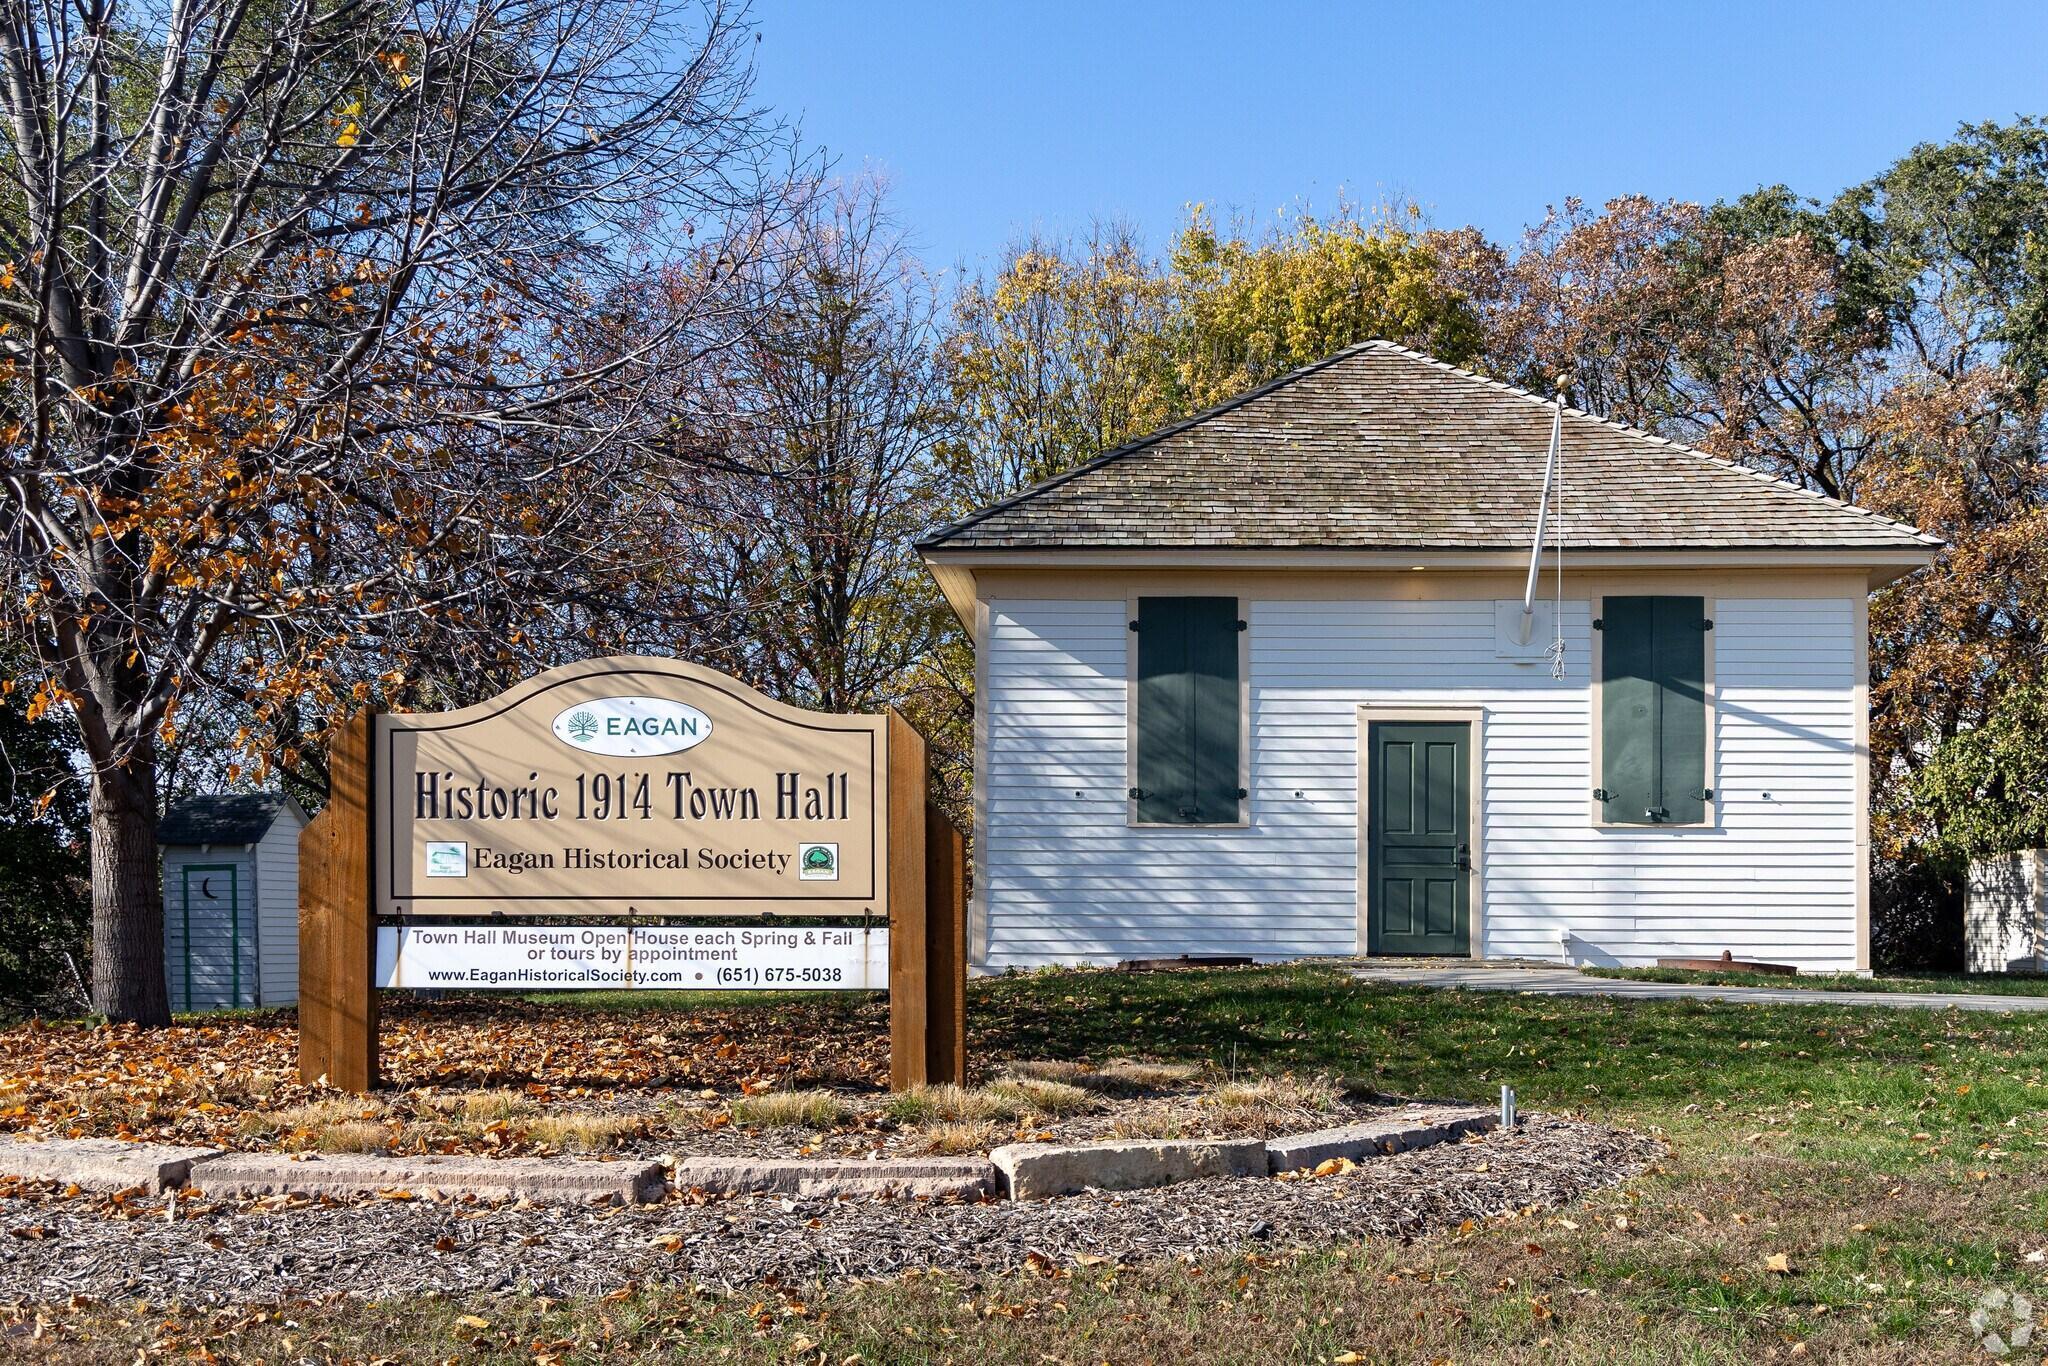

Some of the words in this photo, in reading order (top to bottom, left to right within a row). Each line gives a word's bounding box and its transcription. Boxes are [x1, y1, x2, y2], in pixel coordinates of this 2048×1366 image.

[607, 717, 697, 736] EAGAN
[415, 771, 560, 821] Historic
[575, 772, 653, 821] 1914
[666, 771, 761, 821] Town
[775, 771, 849, 821] Hall
[473, 847, 555, 874] Eagan
[563, 847, 689, 870] Historical
[698, 847, 792, 875] Society
[412, 930, 458, 945] Town
[464, 930, 497, 945] Hall
[502, 930, 575, 945] Museum
[581, 930, 627, 948] Open
[634, 930, 689, 945] House
[694, 930, 735, 946] each
[741, 931, 798, 949] Spring
[803, 932, 817, 946] &
[822, 931, 853, 946] Fall
[527, 949, 546, 960] or
[551, 947, 595, 961] tours
[601, 947, 622, 964] by
[628, 946, 738, 964] appointment
[428, 968, 683, 985] www.EaganHistoricalSociety.com
[716, 967, 759, 985] (651)
[764, 967, 842, 982] 675-5038
